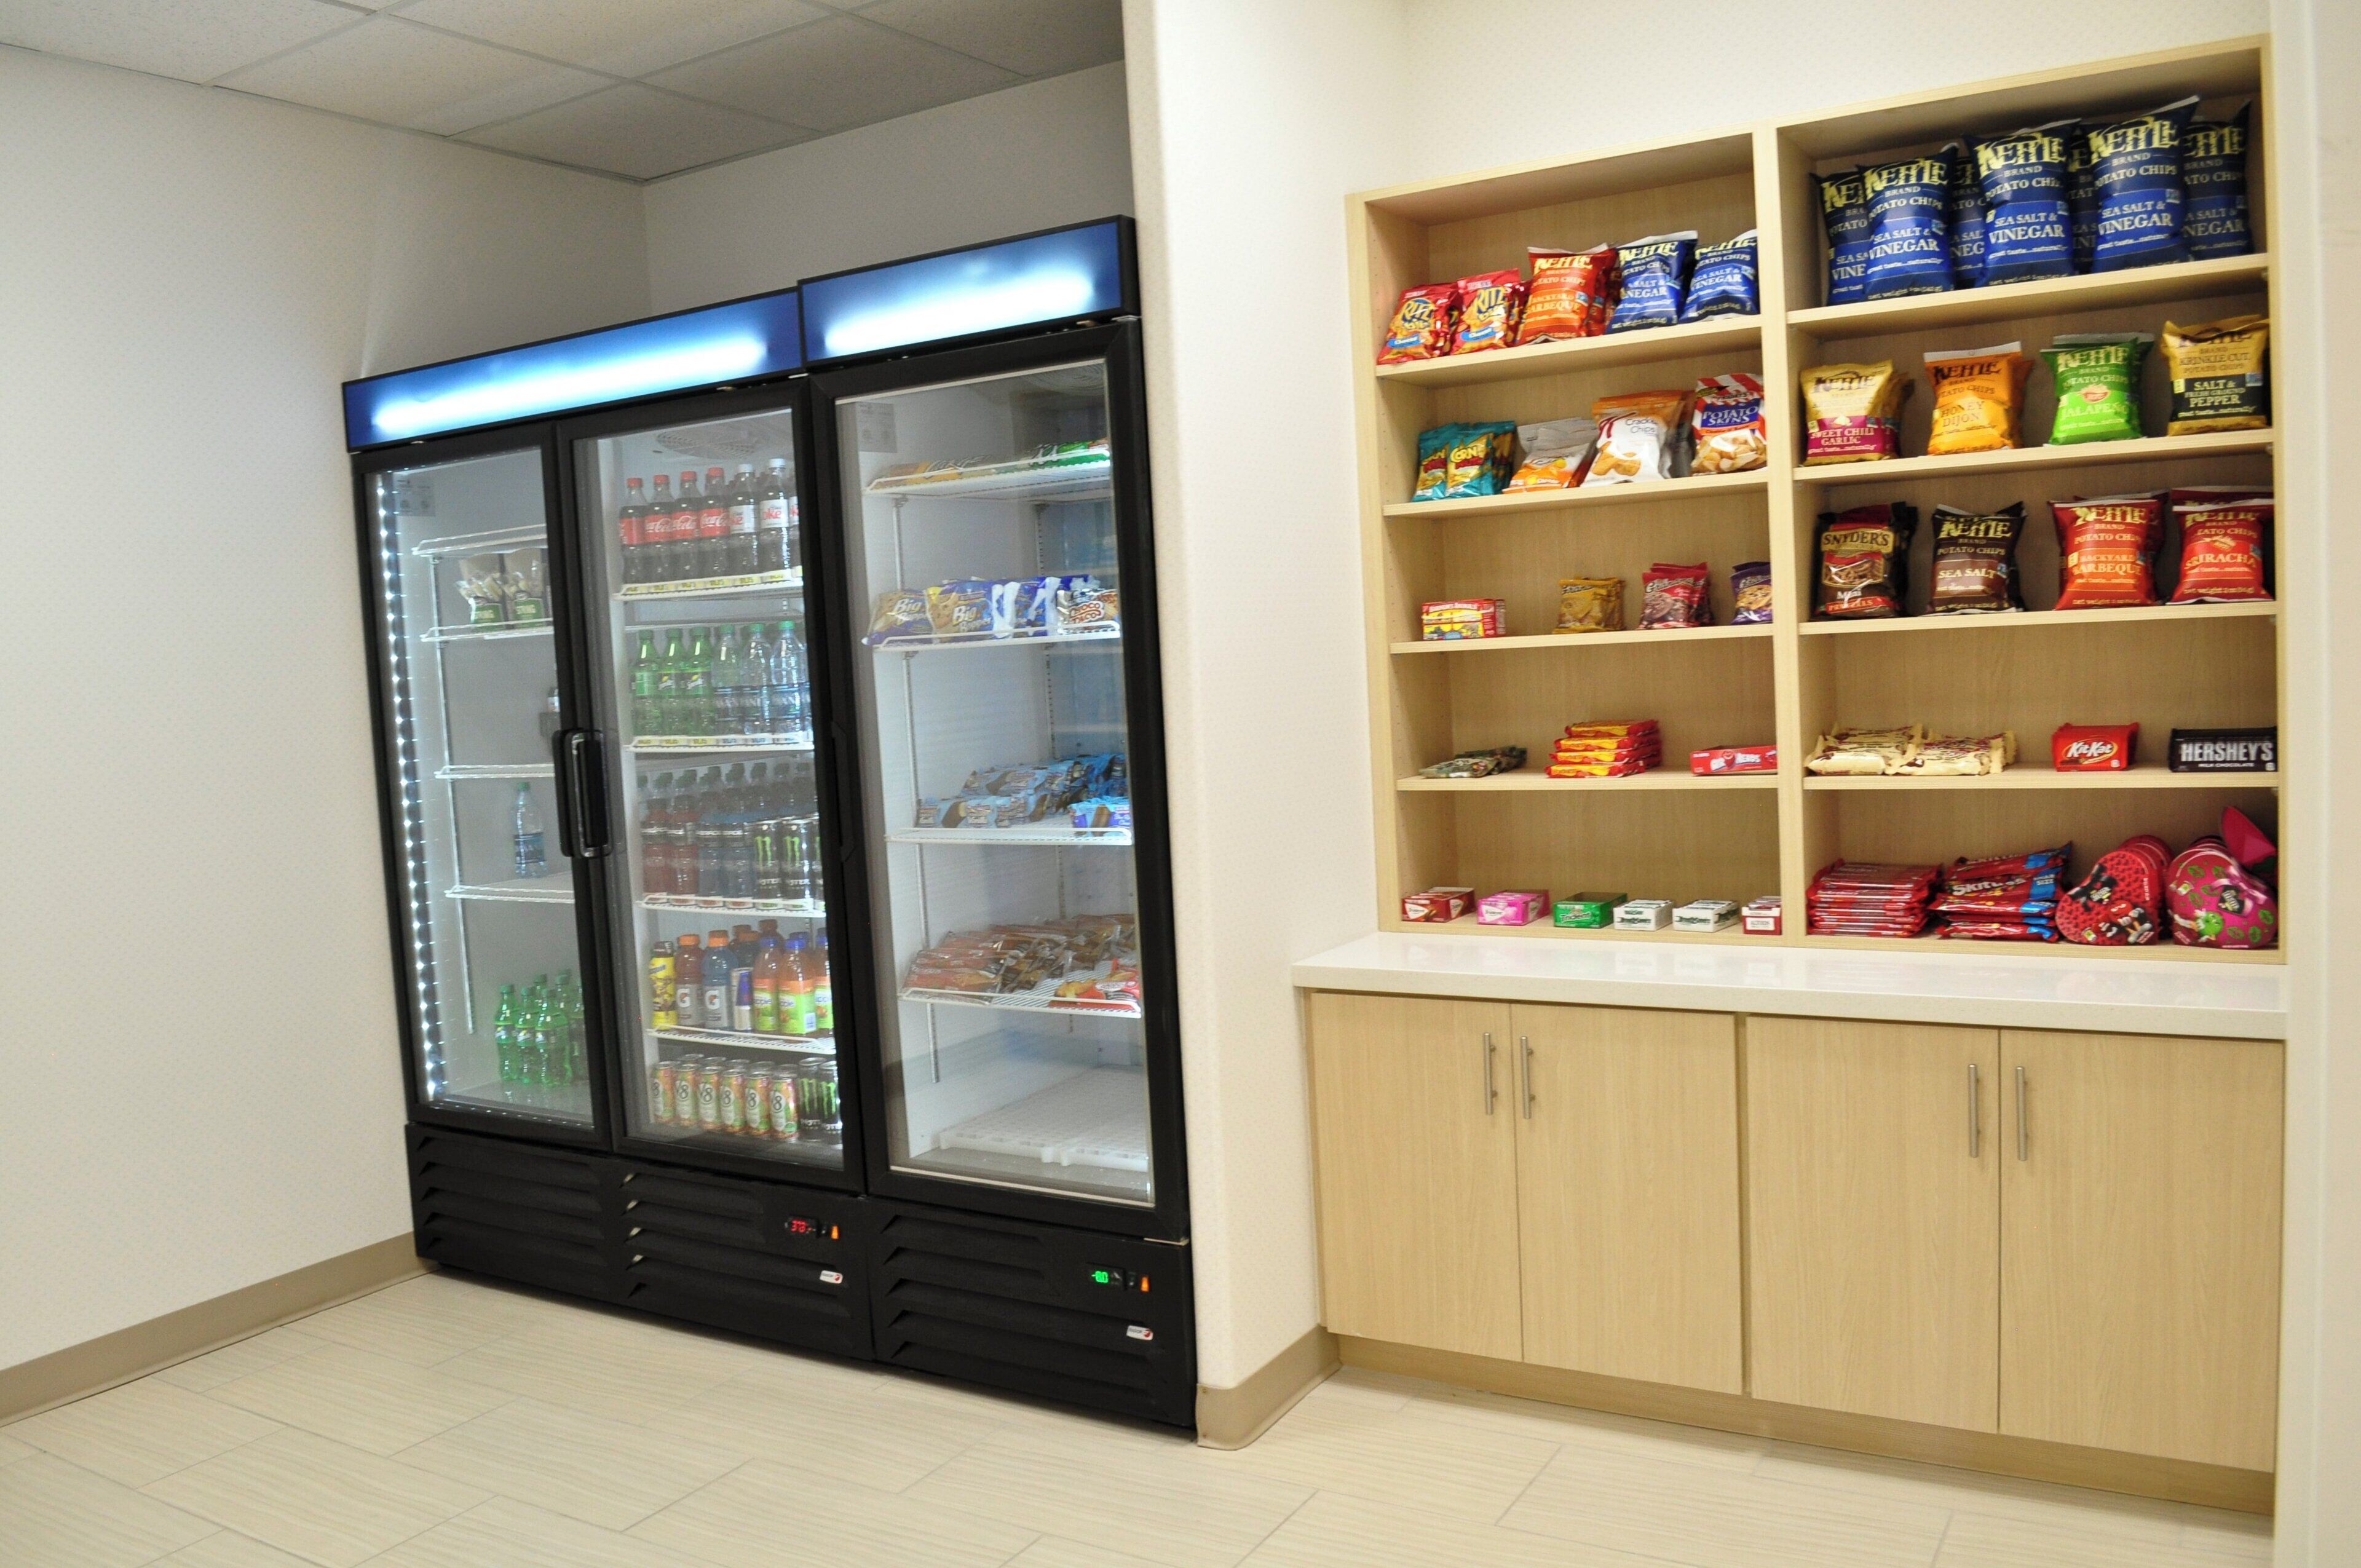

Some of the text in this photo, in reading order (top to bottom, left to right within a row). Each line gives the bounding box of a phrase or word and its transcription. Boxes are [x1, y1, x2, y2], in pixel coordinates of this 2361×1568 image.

[2088, 116, 2180, 166] KETTLE
[1974, 132, 2068, 180] KETTLE
[2111, 152, 2151, 167] BRAND
[2003, 165, 2043, 178] BRAND
[2138, 164, 2178, 176] CHIPS
[1863, 158, 1948, 200] KETTLE
[1884, 186, 1921, 198] BRAND
[2101, 200, 2166, 219] SEA SALT &
[1994, 213, 2058, 228] SEA SALT &
[2097, 213, 2174, 236] VINEGAR
[1893, 227, 1921, 239] SALT
[1988, 224, 2066, 245] VINEGAR
[1869, 238, 1940, 261] VINEGAR
[1836, 251, 1869, 265] SEA SA
[1832, 263, 1866, 281] VINE
[1474, 287, 1507, 312] RITZ
[1627, 287, 1669, 298] NEGAR
[1401, 301, 1434, 322] RITZ
[2194, 379, 2226, 390] SALT
[2189, 394, 2241, 408] PEPPER
[1703, 405, 1759, 419] POTATO
[1940, 401, 1985, 418] HONEY
[1707, 414, 1750, 426] SKINS
[1942, 413, 1980, 427] DIJON
[1809, 428, 1843, 439] SWEET
[1821, 436, 1862, 446] GARLIC
[1937, 520, 2013, 539] KETTLE
[1824, 531, 1889, 547] SNYDER'S
[2183, 553, 2256, 569] SRIRACHA
[1938, 568, 1996, 579] SEA SALT
[893, 598, 923, 614] Big
[952, 604, 978, 627] Big
[2180, 742, 2274, 762] HERSHEY'S
